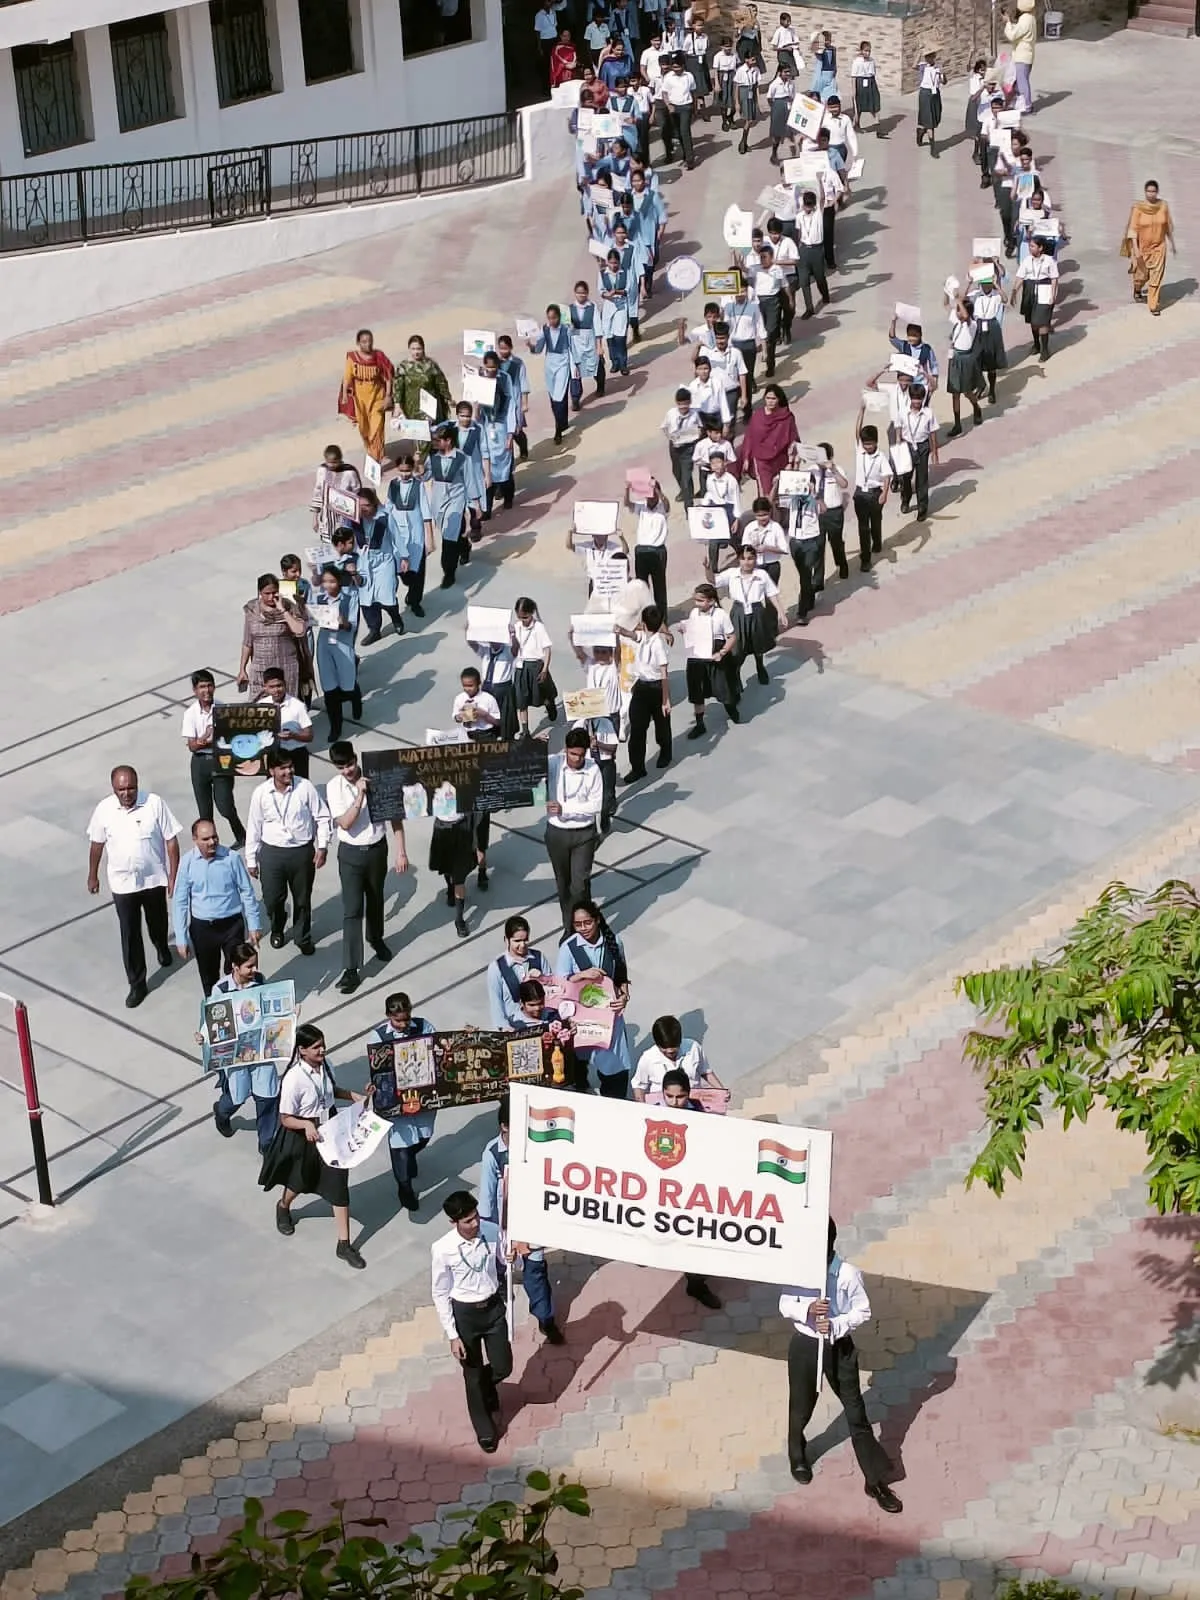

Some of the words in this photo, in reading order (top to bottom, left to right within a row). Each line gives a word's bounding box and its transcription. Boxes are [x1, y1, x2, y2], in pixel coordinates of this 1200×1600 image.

[257, 707, 276, 718] TO
[399, 746, 441, 763] WATER
[444, 742, 509, 758] POLLUTION
[416, 761, 441, 775] SAVE
[443, 759, 479, 771] WATER
[543, 1157, 648, 1201] LORD
[658, 1178, 785, 1223] RAMA
[543, 1190, 646, 1228] PUBLIC
[654, 1211, 783, 1249] SCHOOL
